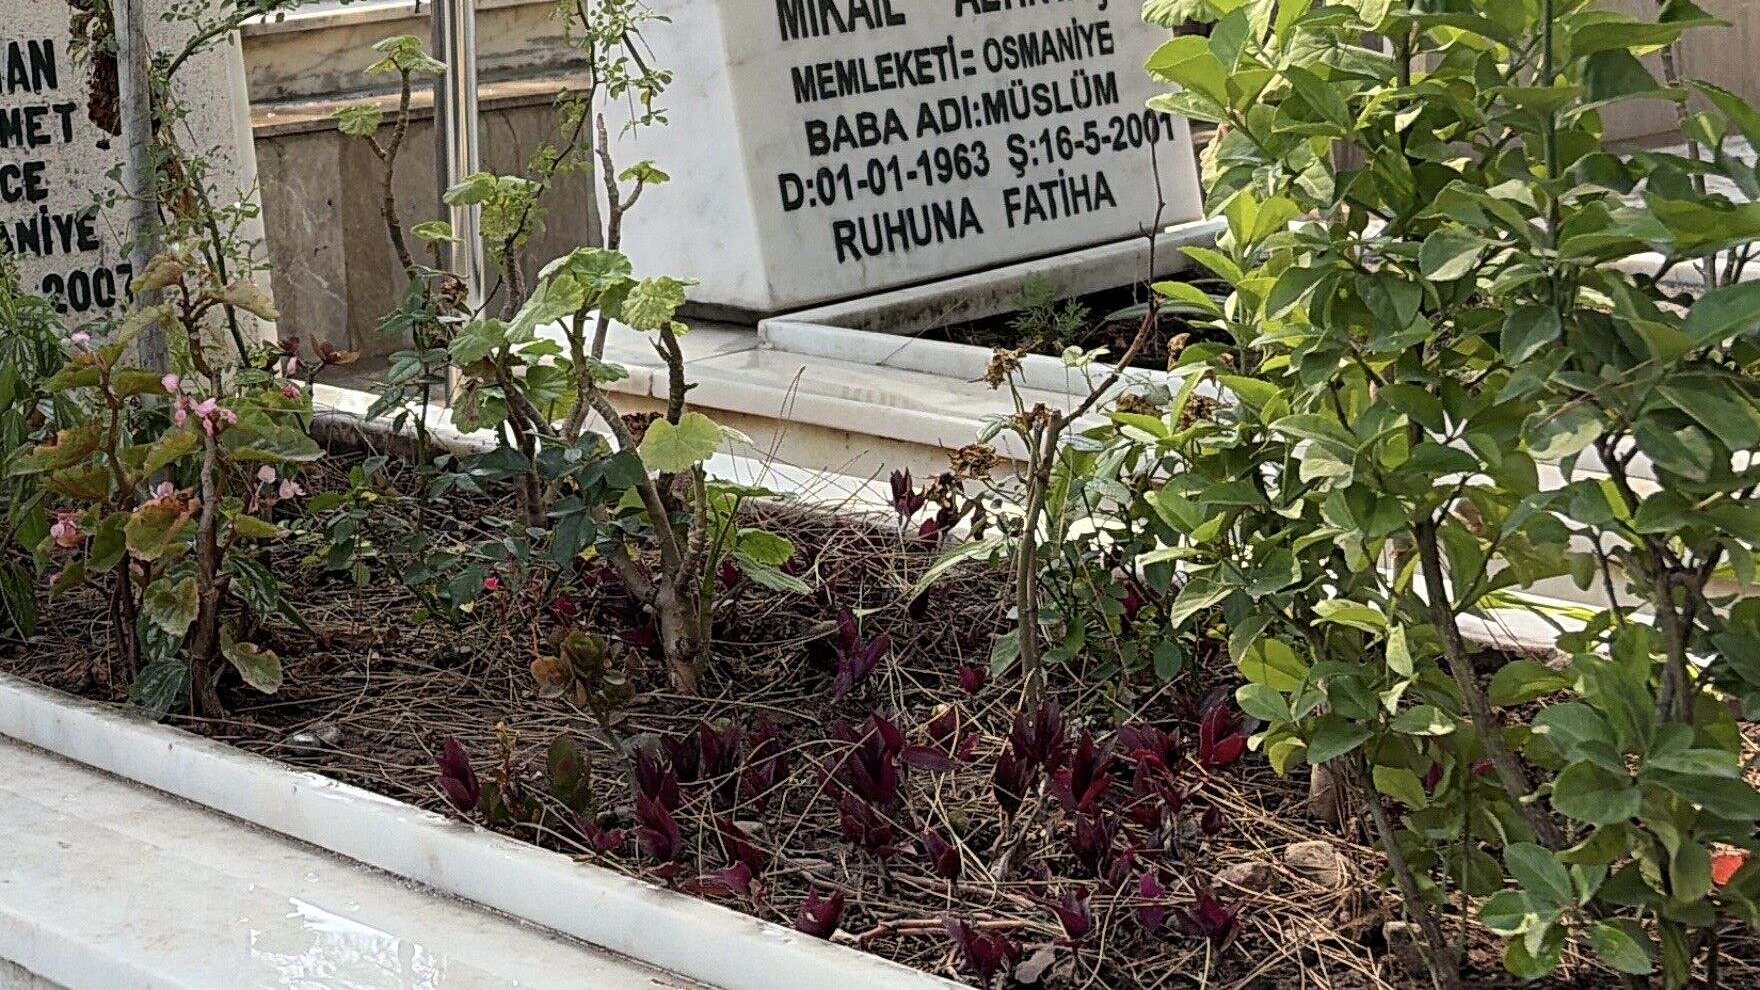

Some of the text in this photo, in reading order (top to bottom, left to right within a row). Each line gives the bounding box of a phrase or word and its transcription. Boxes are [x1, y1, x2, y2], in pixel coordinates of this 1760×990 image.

[983, 17, 1115, 74] OSMANİYE
[778, 108, 1176, 212] D:01-01-1963 Ş:16-5-2001
[805, 108, 909, 157] BABA
[832, 168, 1118, 263] RUHUNA FATİHA
